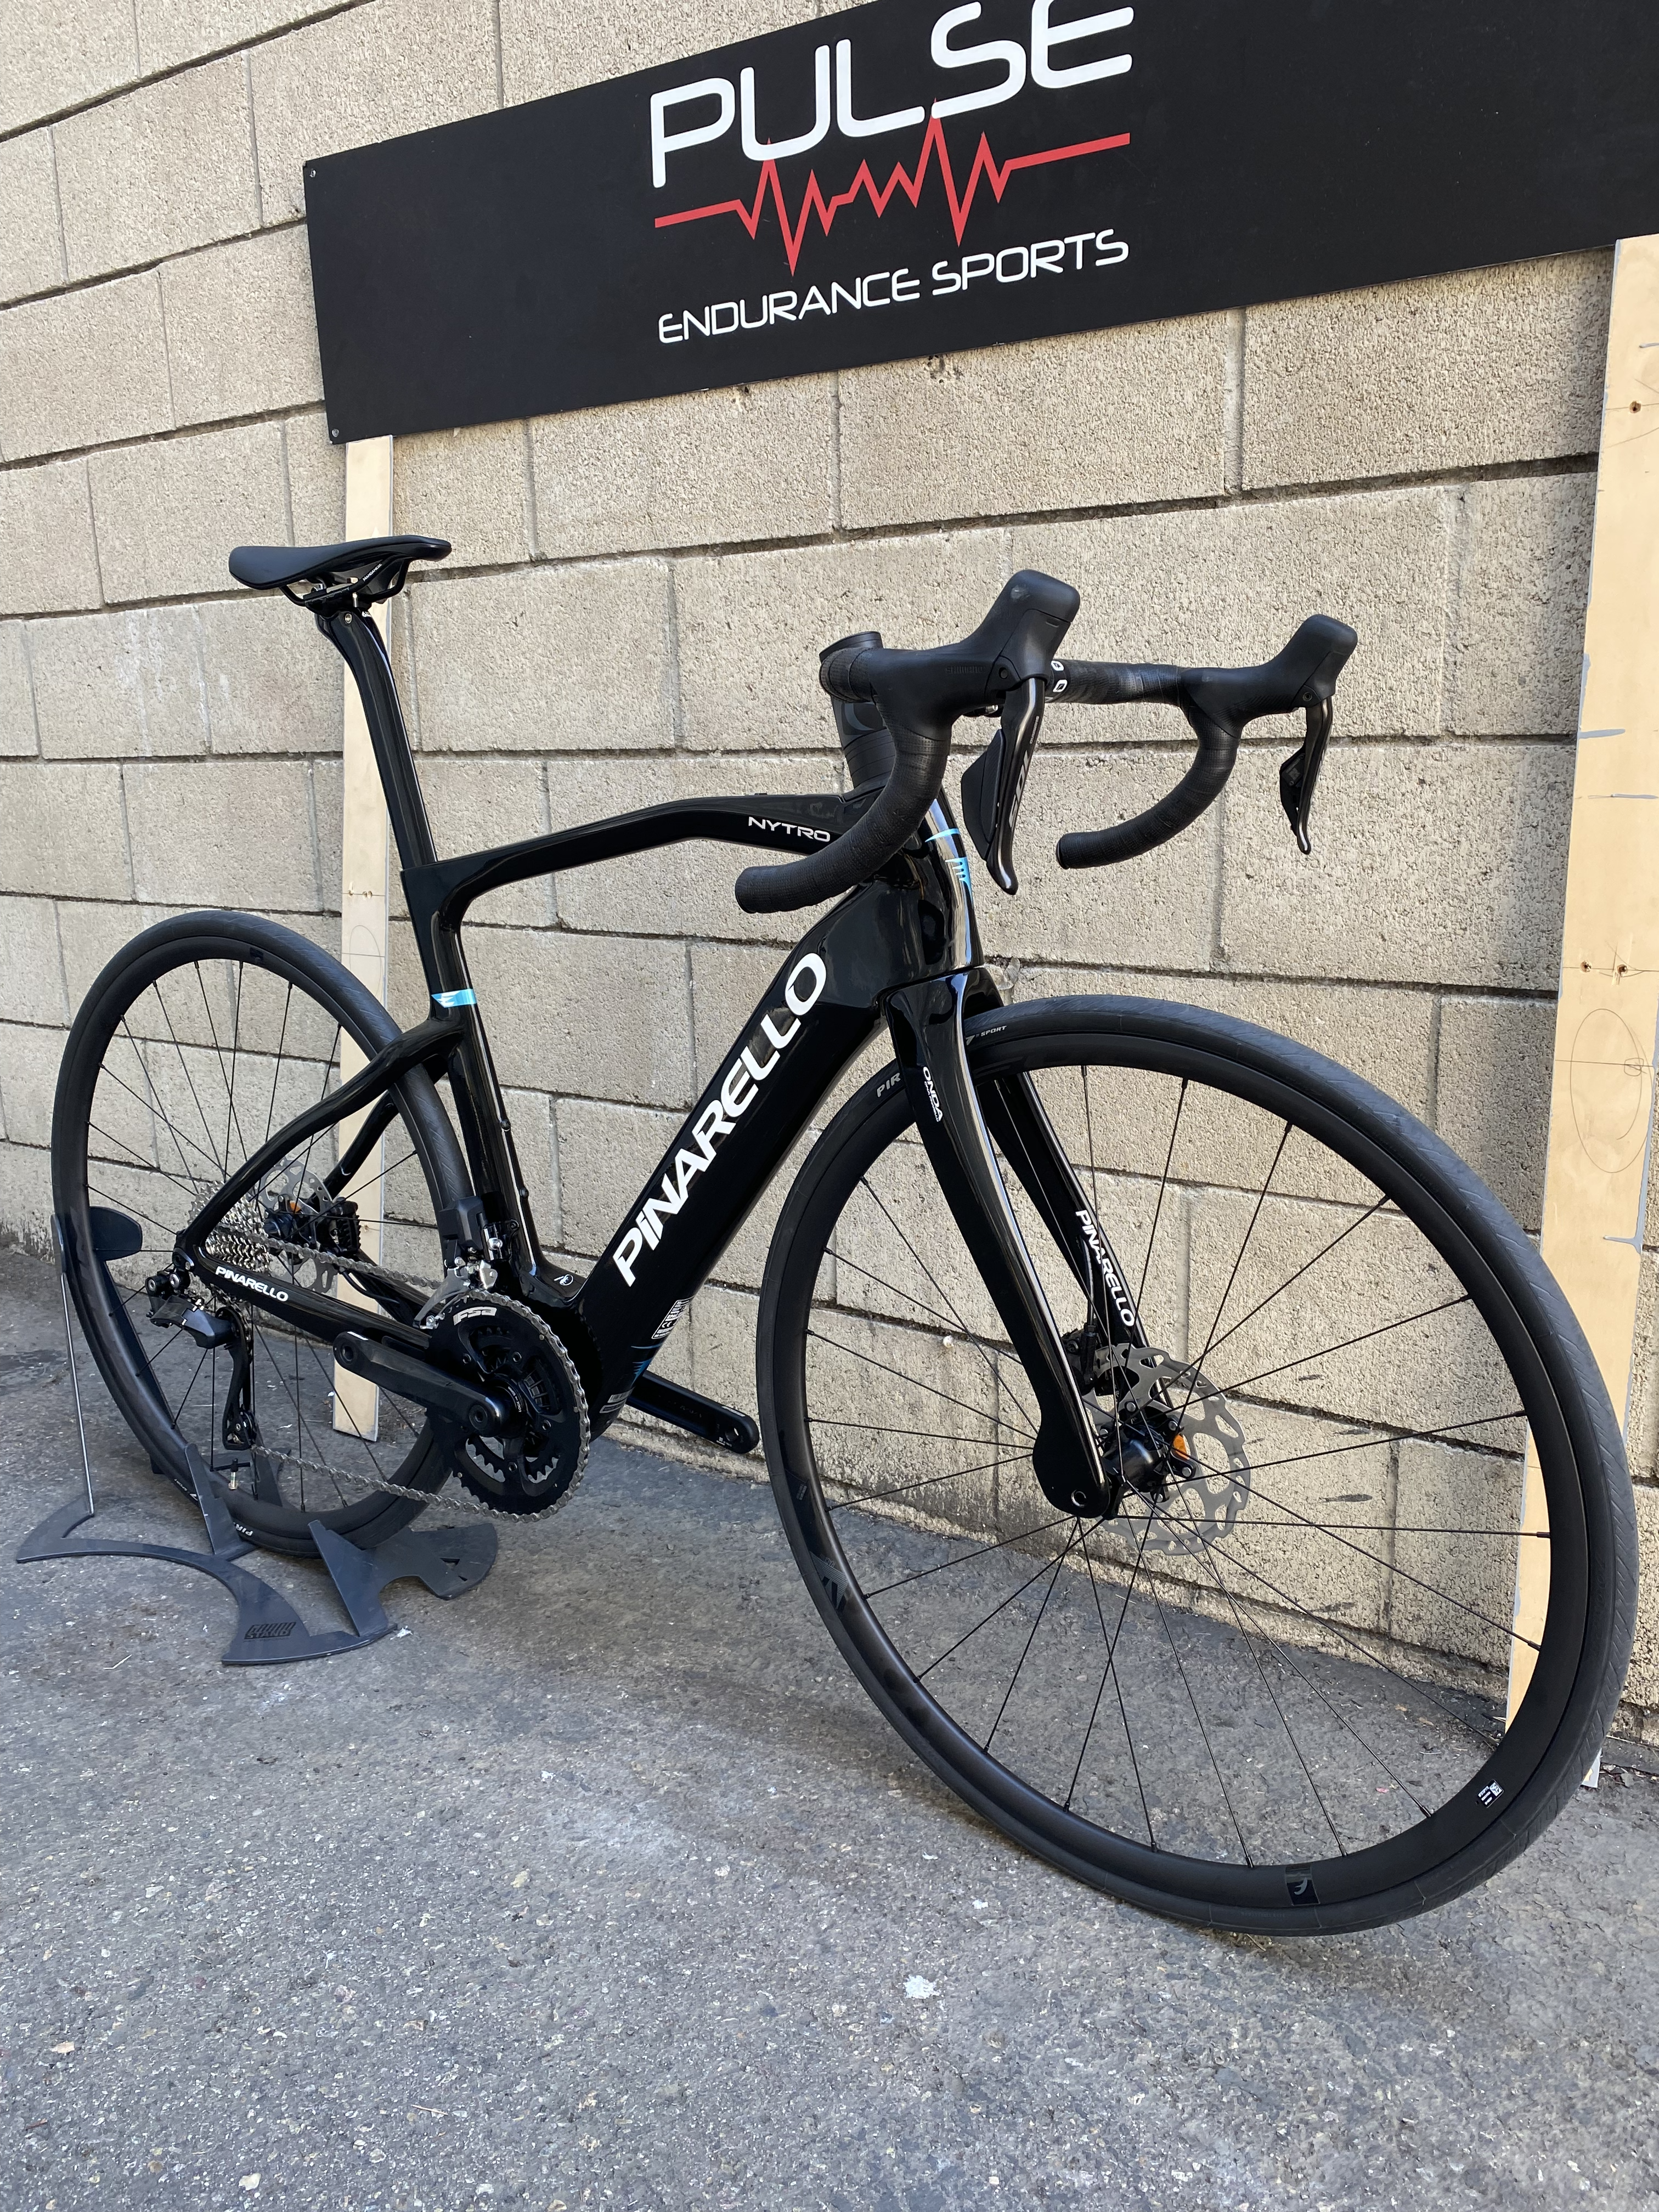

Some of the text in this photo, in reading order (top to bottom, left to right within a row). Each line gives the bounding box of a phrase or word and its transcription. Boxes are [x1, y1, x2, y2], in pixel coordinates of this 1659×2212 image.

[650, 0, 1134, 188] PULSE
[658, 229, 1129, 343] ENDURANCE SPORTS
[748, 816, 831, 842] NYTRO
[980, 1025, 1007, 1036] SPORT
[612, 952, 827, 1287] PINARELLO
[923, 1066, 943, 1121] ONDA
[215, 1266, 289, 1302] PINARELLO
[1075, 1209, 1135, 1327] PINARELLO
[234, 1522, 253, 1536] PIR
